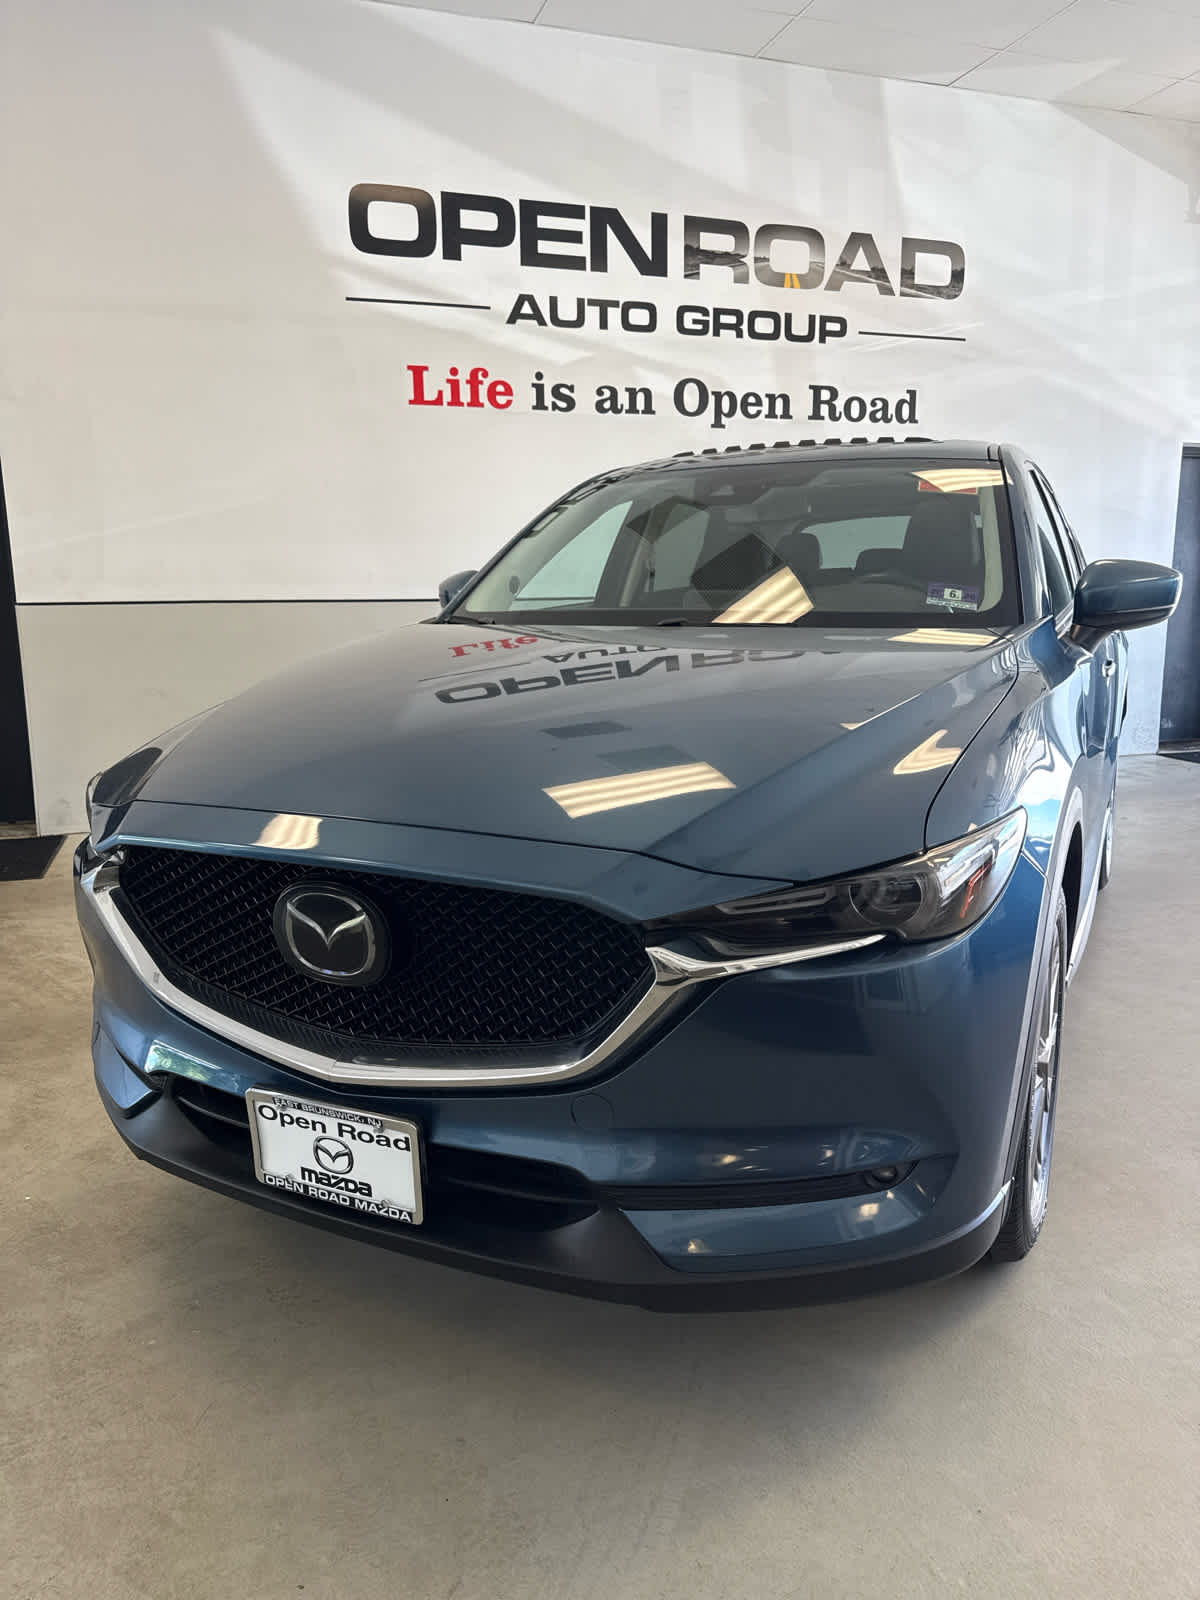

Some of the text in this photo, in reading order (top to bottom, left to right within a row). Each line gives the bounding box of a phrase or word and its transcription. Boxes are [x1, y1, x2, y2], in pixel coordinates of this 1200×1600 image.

[348, 183, 967, 301] OPEN ROAD
[505, 293, 848, 345] AUTO GROUP
[406, 364, 919, 429] Life is an Open Road
[258, 1104, 411, 1152] Open Road
[273, 1097, 299, 1110] EAST
[368, 1117, 382, 1129] NJ
[265, 1175, 412, 1223] OPEN ROAD MAZDA
